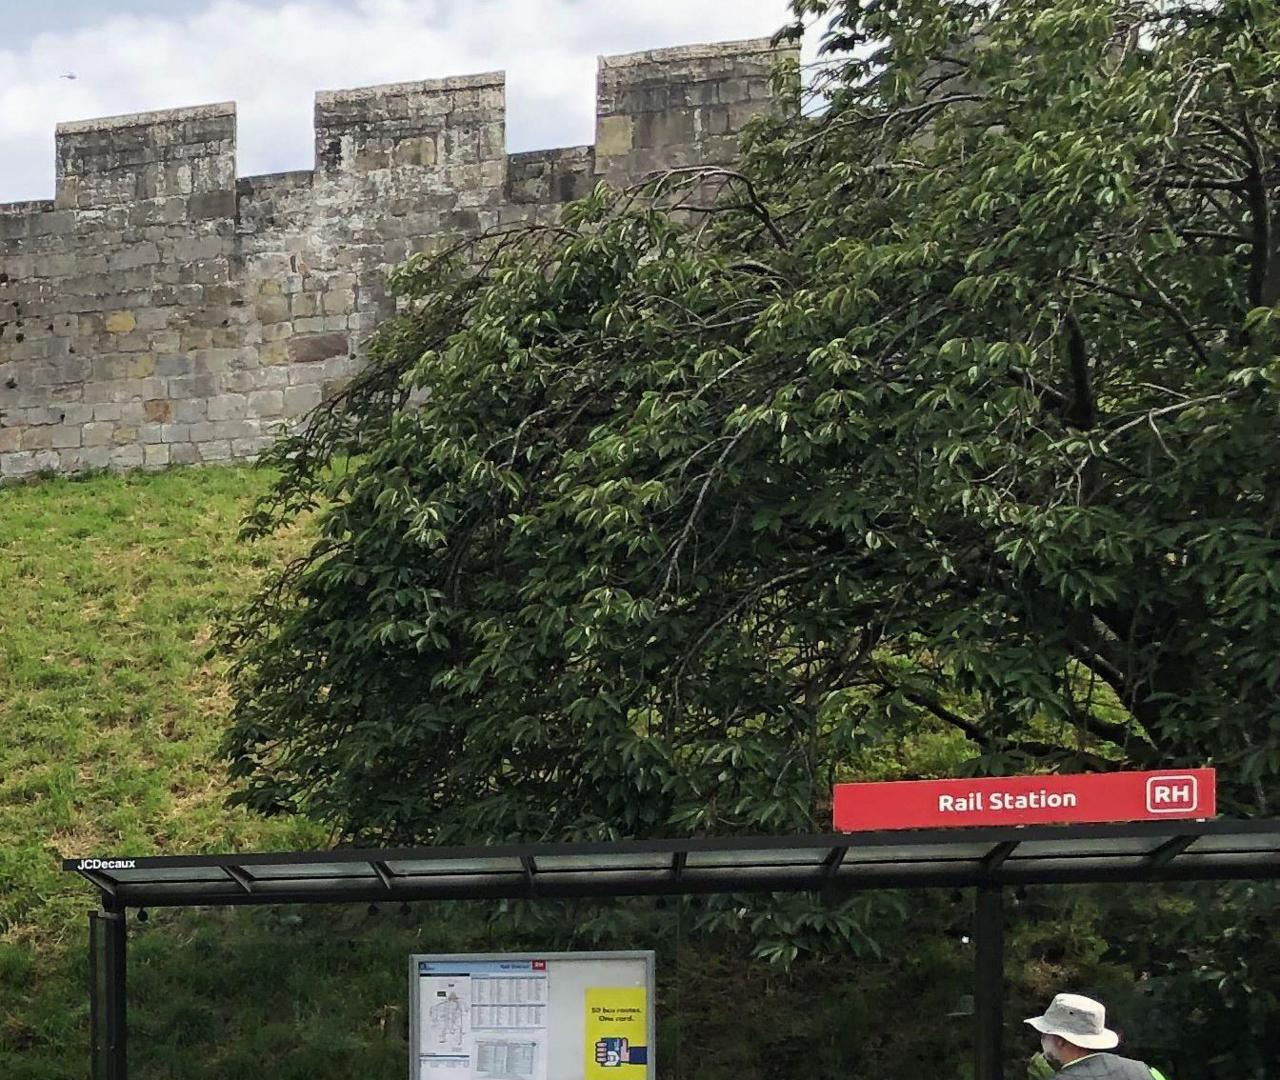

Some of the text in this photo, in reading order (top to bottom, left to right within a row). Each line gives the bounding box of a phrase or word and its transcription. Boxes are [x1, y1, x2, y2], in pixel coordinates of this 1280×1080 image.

[938, 789, 1077, 812] Rail Station
[1154, 785, 1190, 804] RH
[77, 859, 136, 870] JCDecaux
